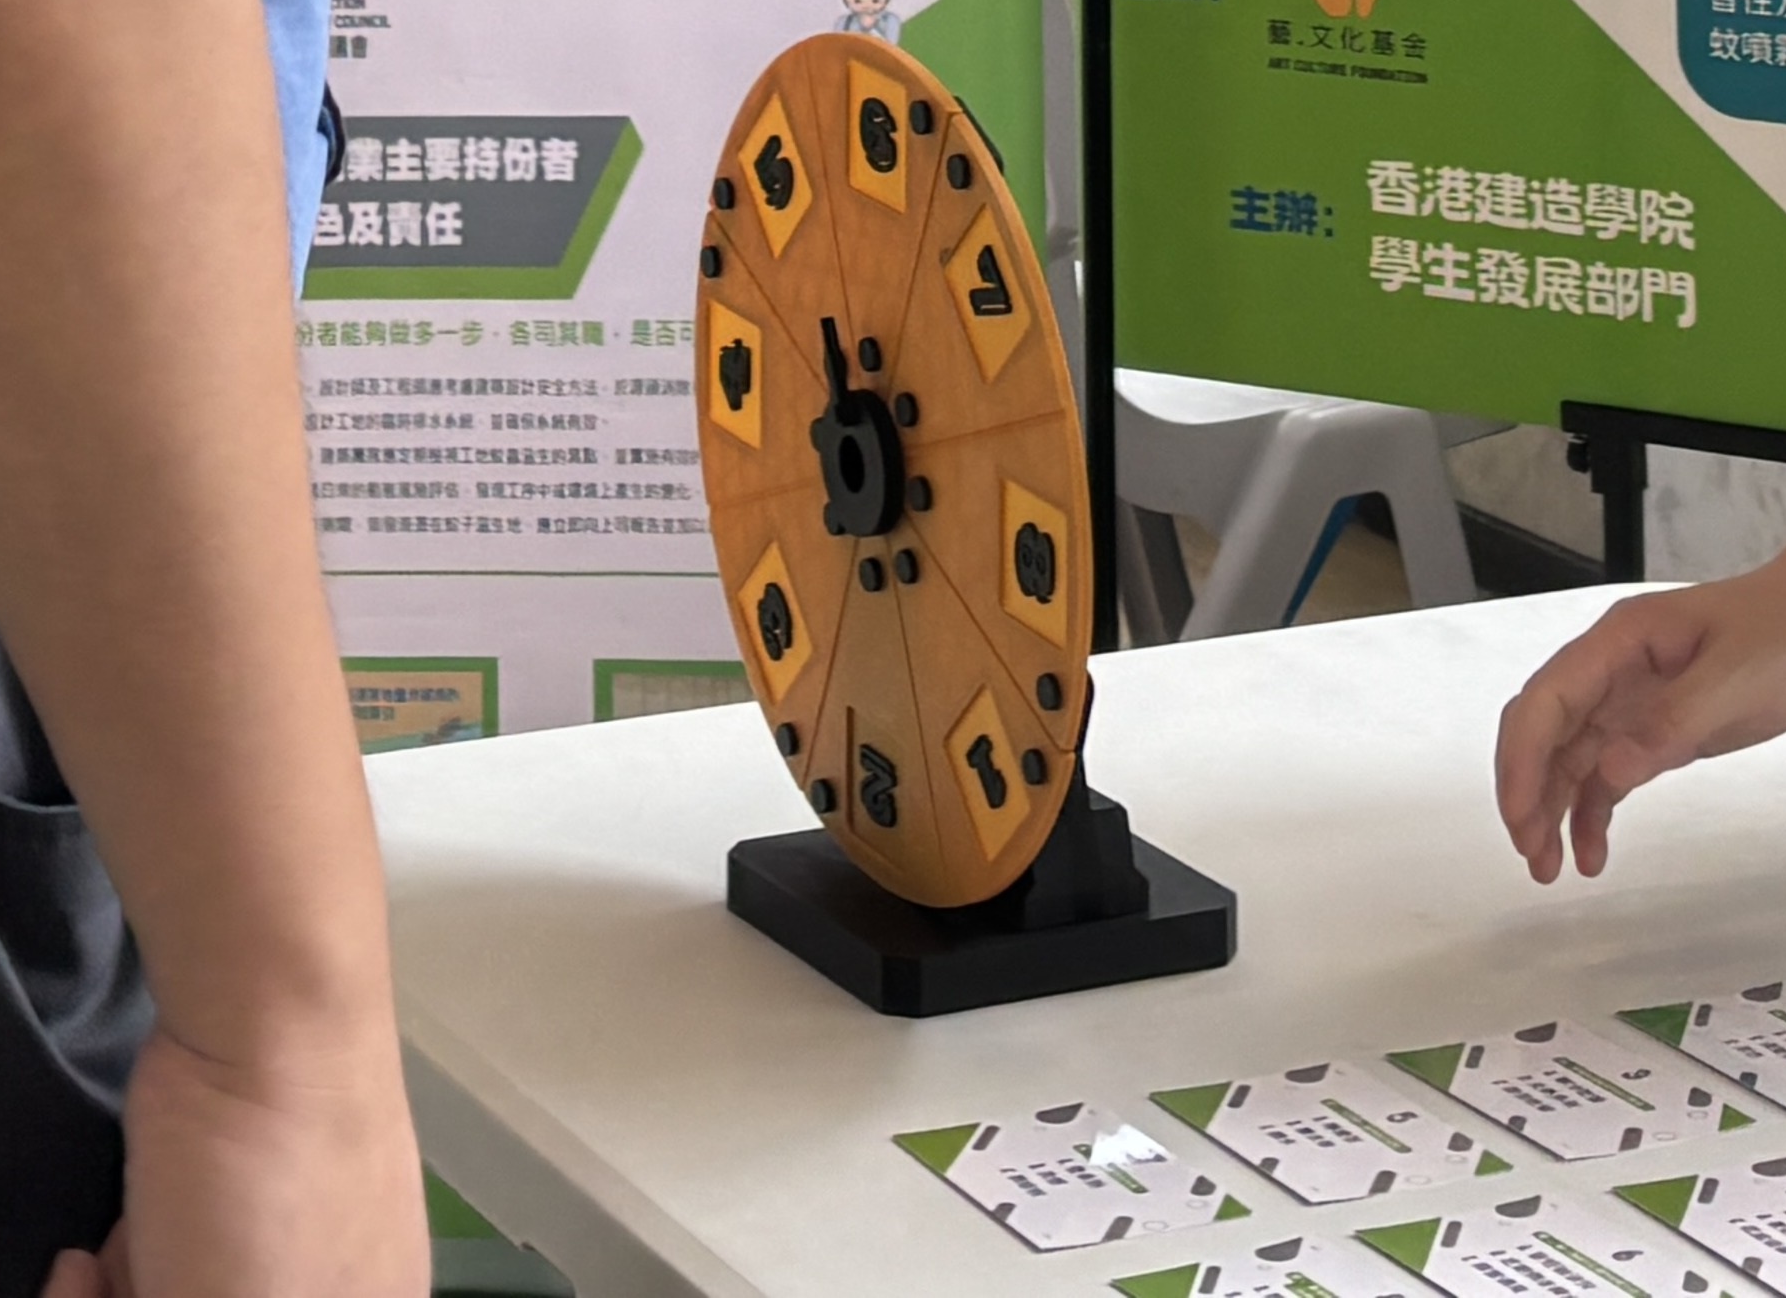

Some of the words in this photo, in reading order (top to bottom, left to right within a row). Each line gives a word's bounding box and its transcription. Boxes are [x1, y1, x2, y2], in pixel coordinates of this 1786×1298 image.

[335, 136, 579, 182] 業主要持份者
[754, 135, 794, 210] 5
[1367, 159, 1695, 250] 香港建造學院
[1369, 235, 1698, 328] 學生發展部門
[1015, 522, 1056, 603] 8
[860, 744, 897, 828] 2
[966, 734, 1007, 809] 1
